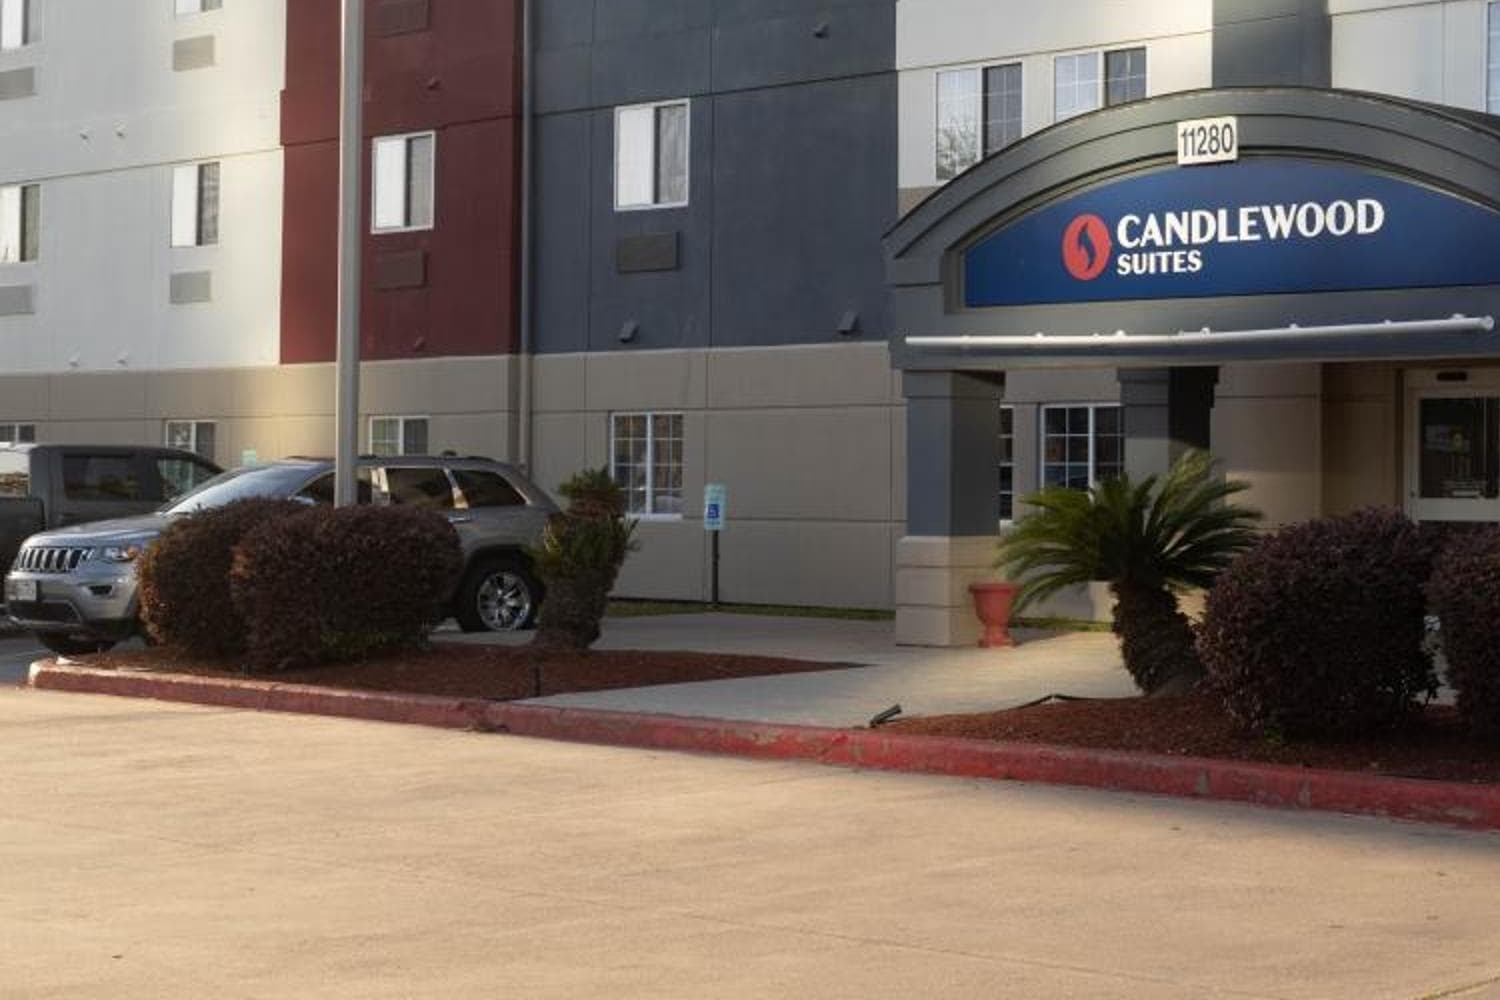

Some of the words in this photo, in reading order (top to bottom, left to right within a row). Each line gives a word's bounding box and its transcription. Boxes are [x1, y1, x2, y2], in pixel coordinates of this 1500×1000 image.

[1181, 123, 1234, 157] 11280
[1117, 199, 1385, 249] CANDLEWOOD
[1117, 250, 1203, 276] SUITES
